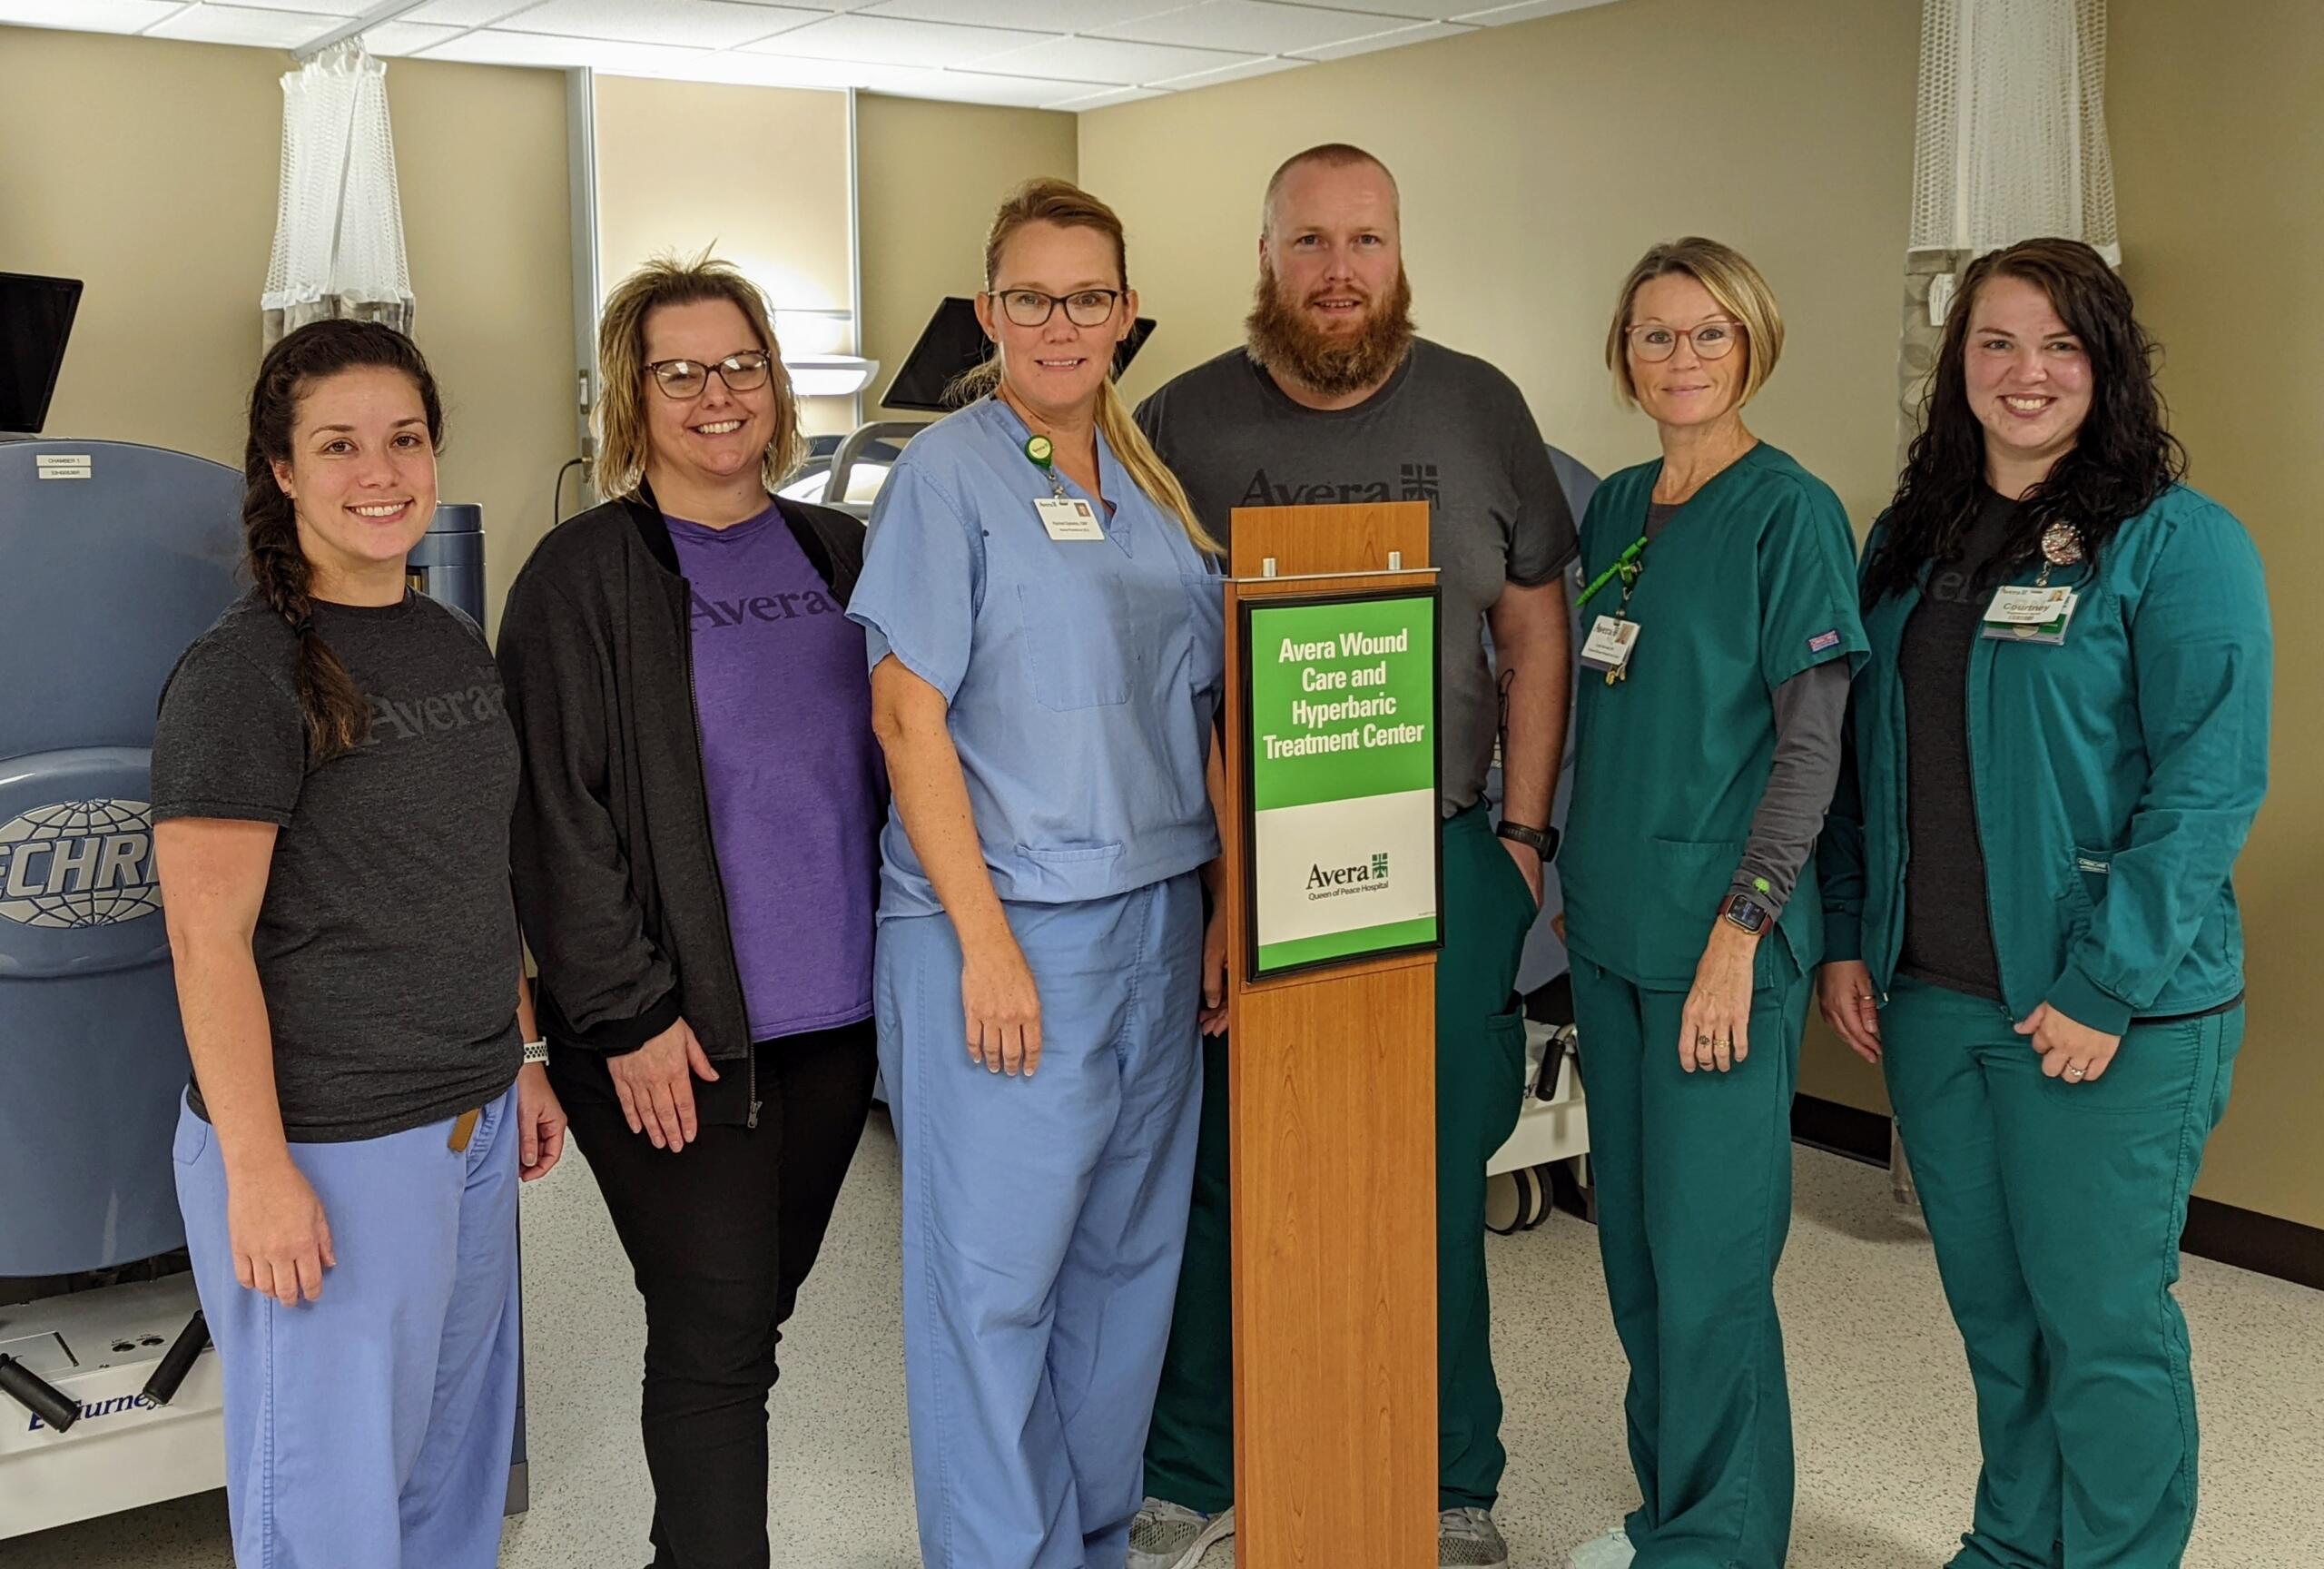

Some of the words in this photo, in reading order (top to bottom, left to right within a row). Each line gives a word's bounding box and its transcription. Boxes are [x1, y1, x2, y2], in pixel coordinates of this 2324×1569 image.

[1240, 468, 1391, 506] Avera
[690, 590, 836, 628] Avera
[2003, 602, 2051, 612] Courtney
[1278, 638, 1335, 663] Avera
[1339, 628, 1408, 656] Wound
[1302, 667, 1346, 692] Care
[1351, 661, 1386, 686] and
[1292, 692, 1396, 728] Hyperbaric
[1263, 727, 1360, 759] Treatment
[1364, 723, 1425, 747] Center
[1305, 863, 1369, 890] Avera
[1308, 890, 1332, 901] Queen
[1332, 888, 1340, 896] of
[1341, 885, 1361, 895] Peace
[1361, 881, 1389, 893] Hospital
